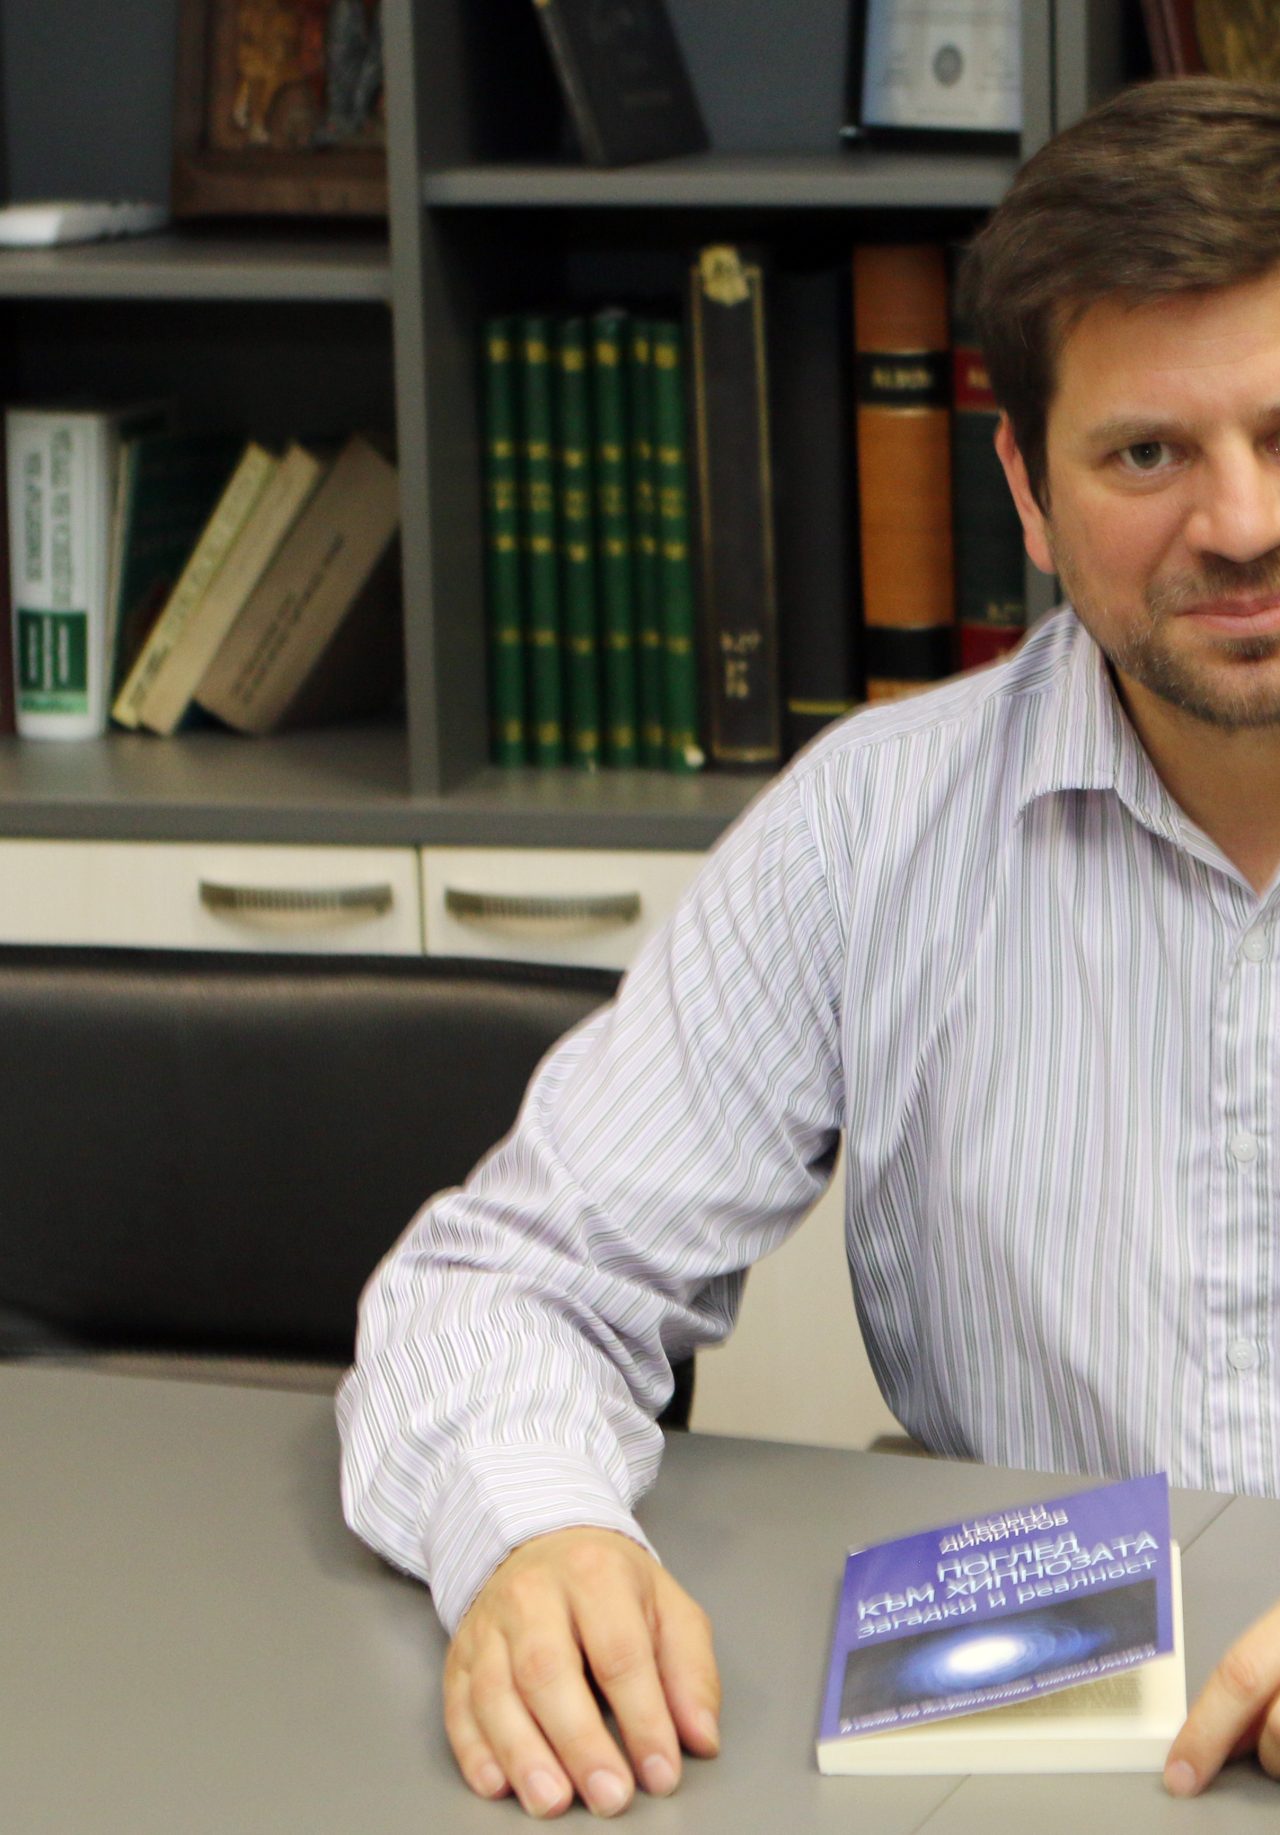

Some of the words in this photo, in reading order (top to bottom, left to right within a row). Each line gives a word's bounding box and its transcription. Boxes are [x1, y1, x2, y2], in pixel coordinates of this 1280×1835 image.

[940, 1512, 1069, 1554] ДИМИТРОВ
[962, 1507, 1047, 1537] ГЕОРГИ
[857, 1586, 935, 1620] КЪМ
[945, 1534, 1160, 1599] ХИПНОЗАТА
[937, 1534, 1080, 1582] ПОГЛЕД
[857, 1599, 977, 1639] Загадки
[1017, 1556, 1158, 1604] реалност
